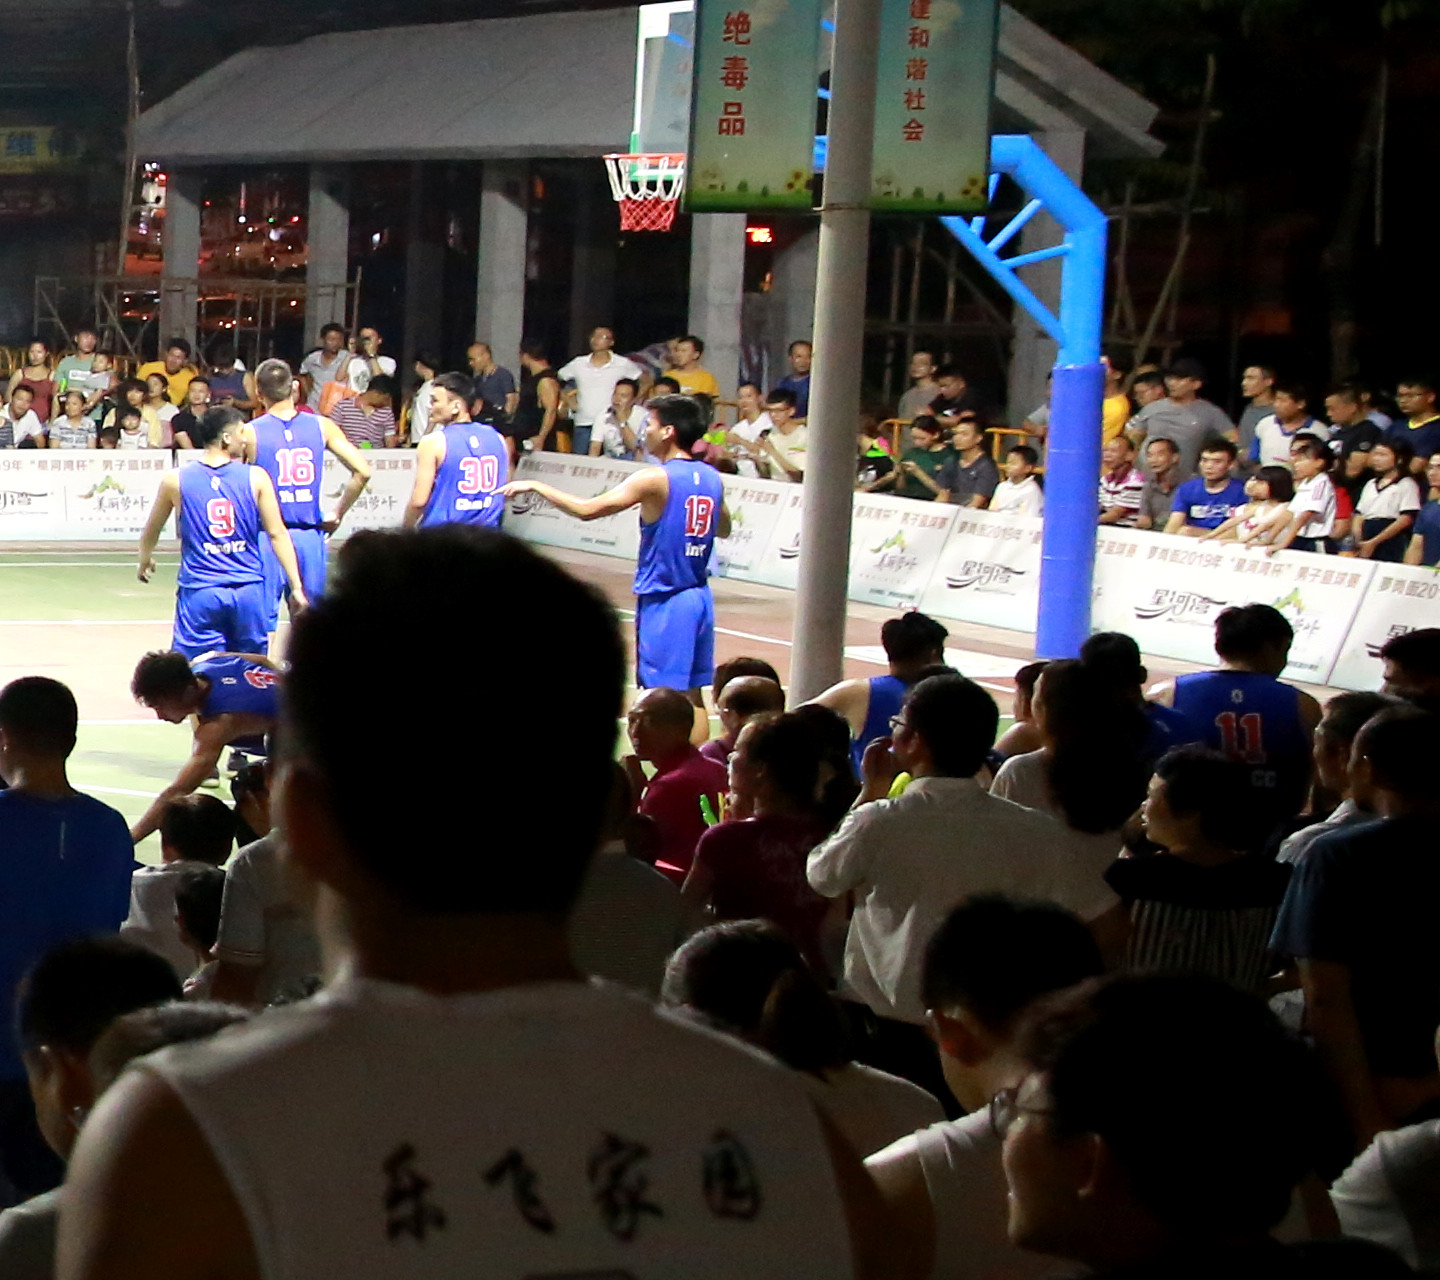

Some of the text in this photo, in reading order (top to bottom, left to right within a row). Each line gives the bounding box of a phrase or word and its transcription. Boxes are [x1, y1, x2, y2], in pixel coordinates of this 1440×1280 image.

[275, 447, 315, 487] 16
[457, 454, 498, 495] 30
[206, 497, 235, 538] 9
[1214, 710, 1267, 764] 11
